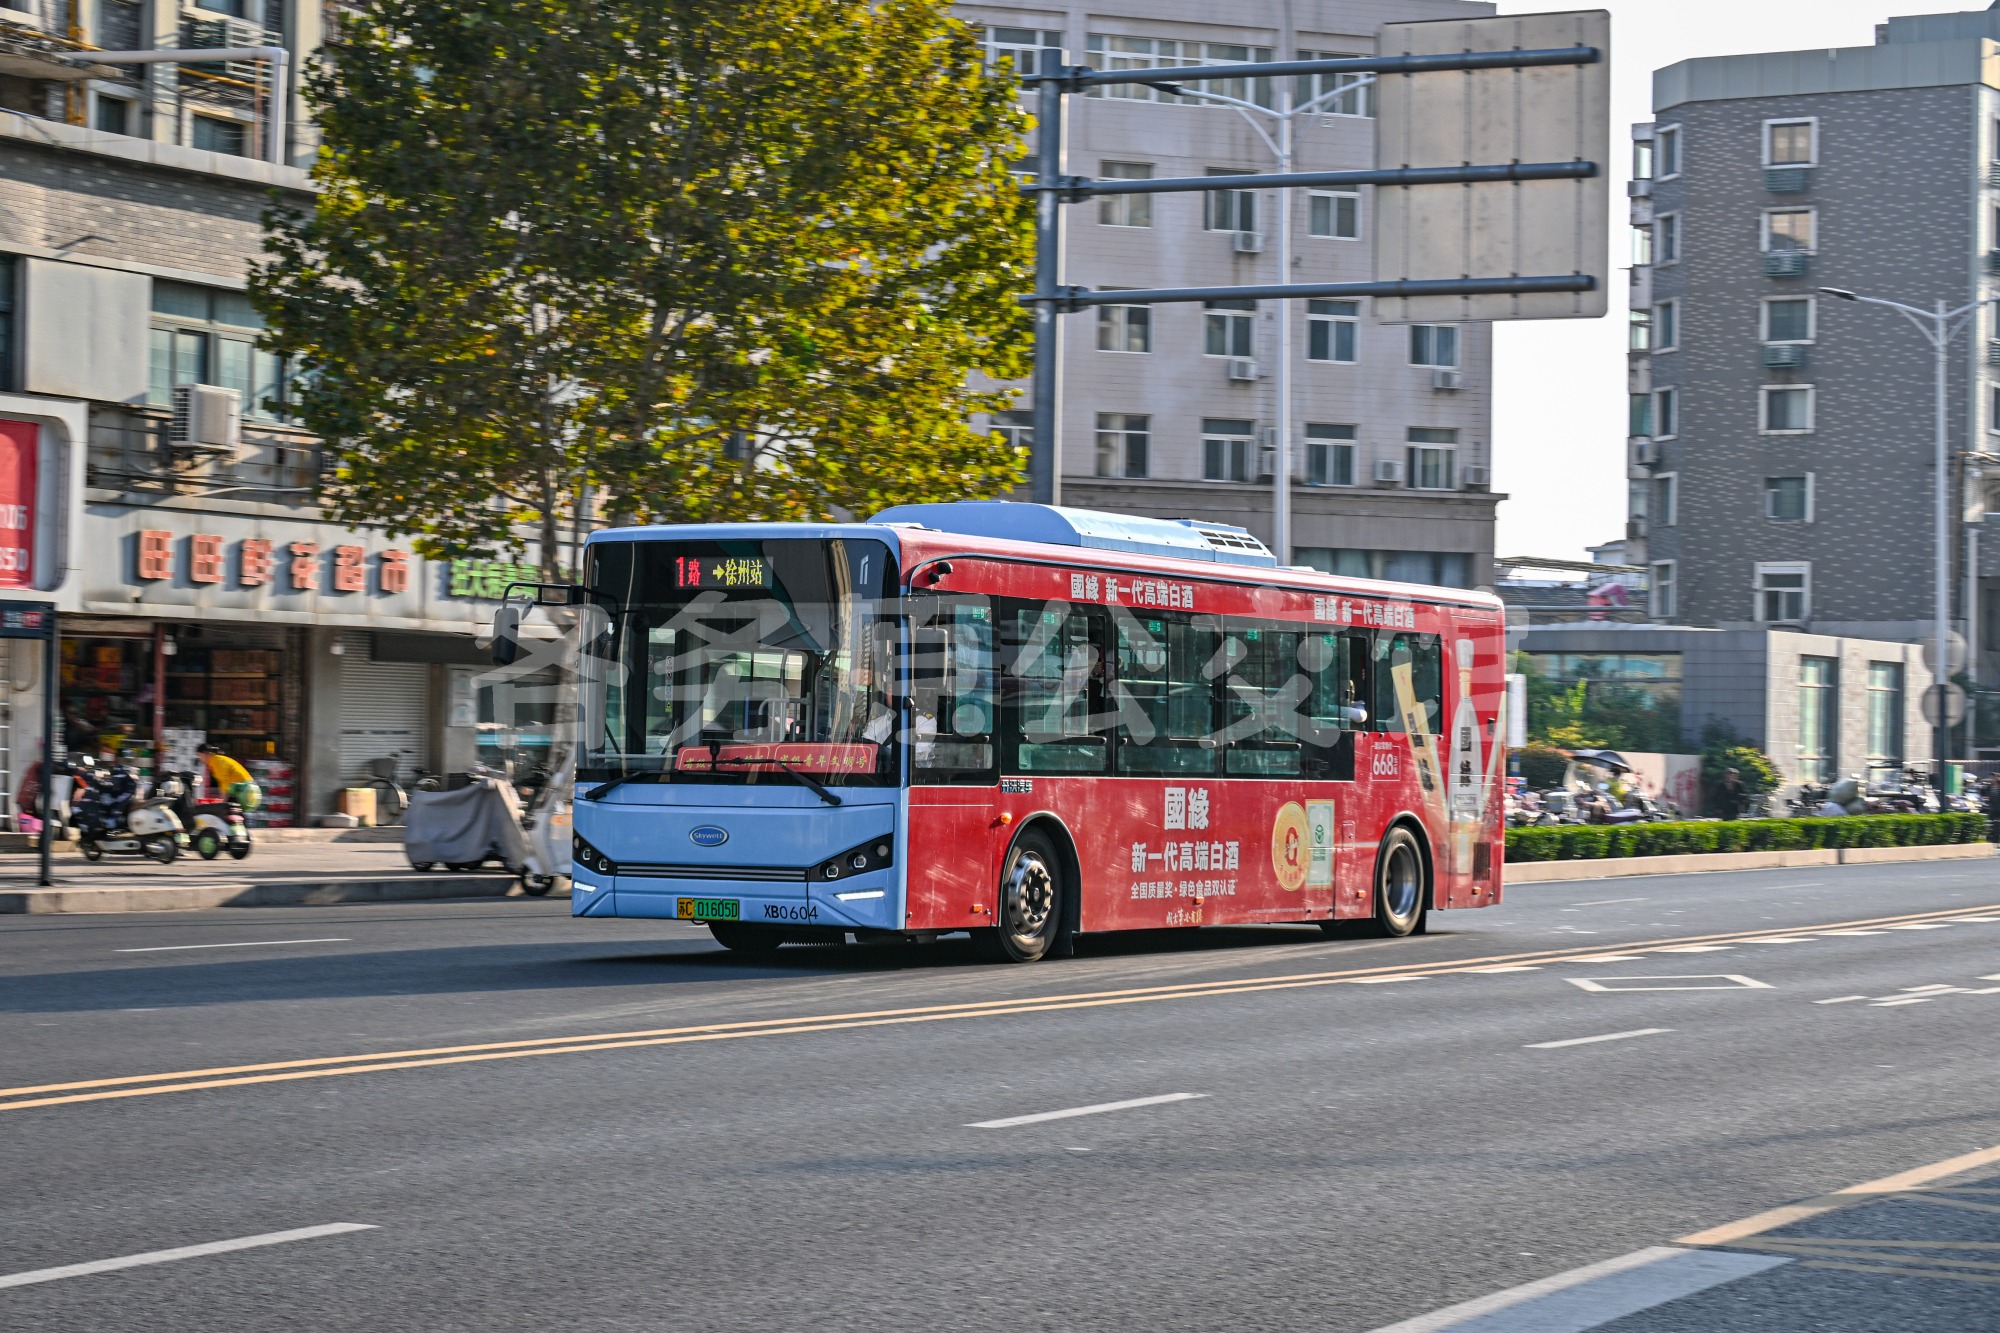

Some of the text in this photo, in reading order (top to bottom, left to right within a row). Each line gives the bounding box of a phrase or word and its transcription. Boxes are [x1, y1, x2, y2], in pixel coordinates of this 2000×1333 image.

[139, 529, 409, 594] 旺旺鲜花超市
[725, 558, 763, 586] 徐州站
[1105, 576, 1194, 609] 新一代高端白酒
[1342, 600, 1415, 629] 新一代高端白酒
[1373, 753, 1394, 776] 668
[1131, 841, 1239, 872] 新一代高端白酒
[763, 904, 818, 920] XB0604
